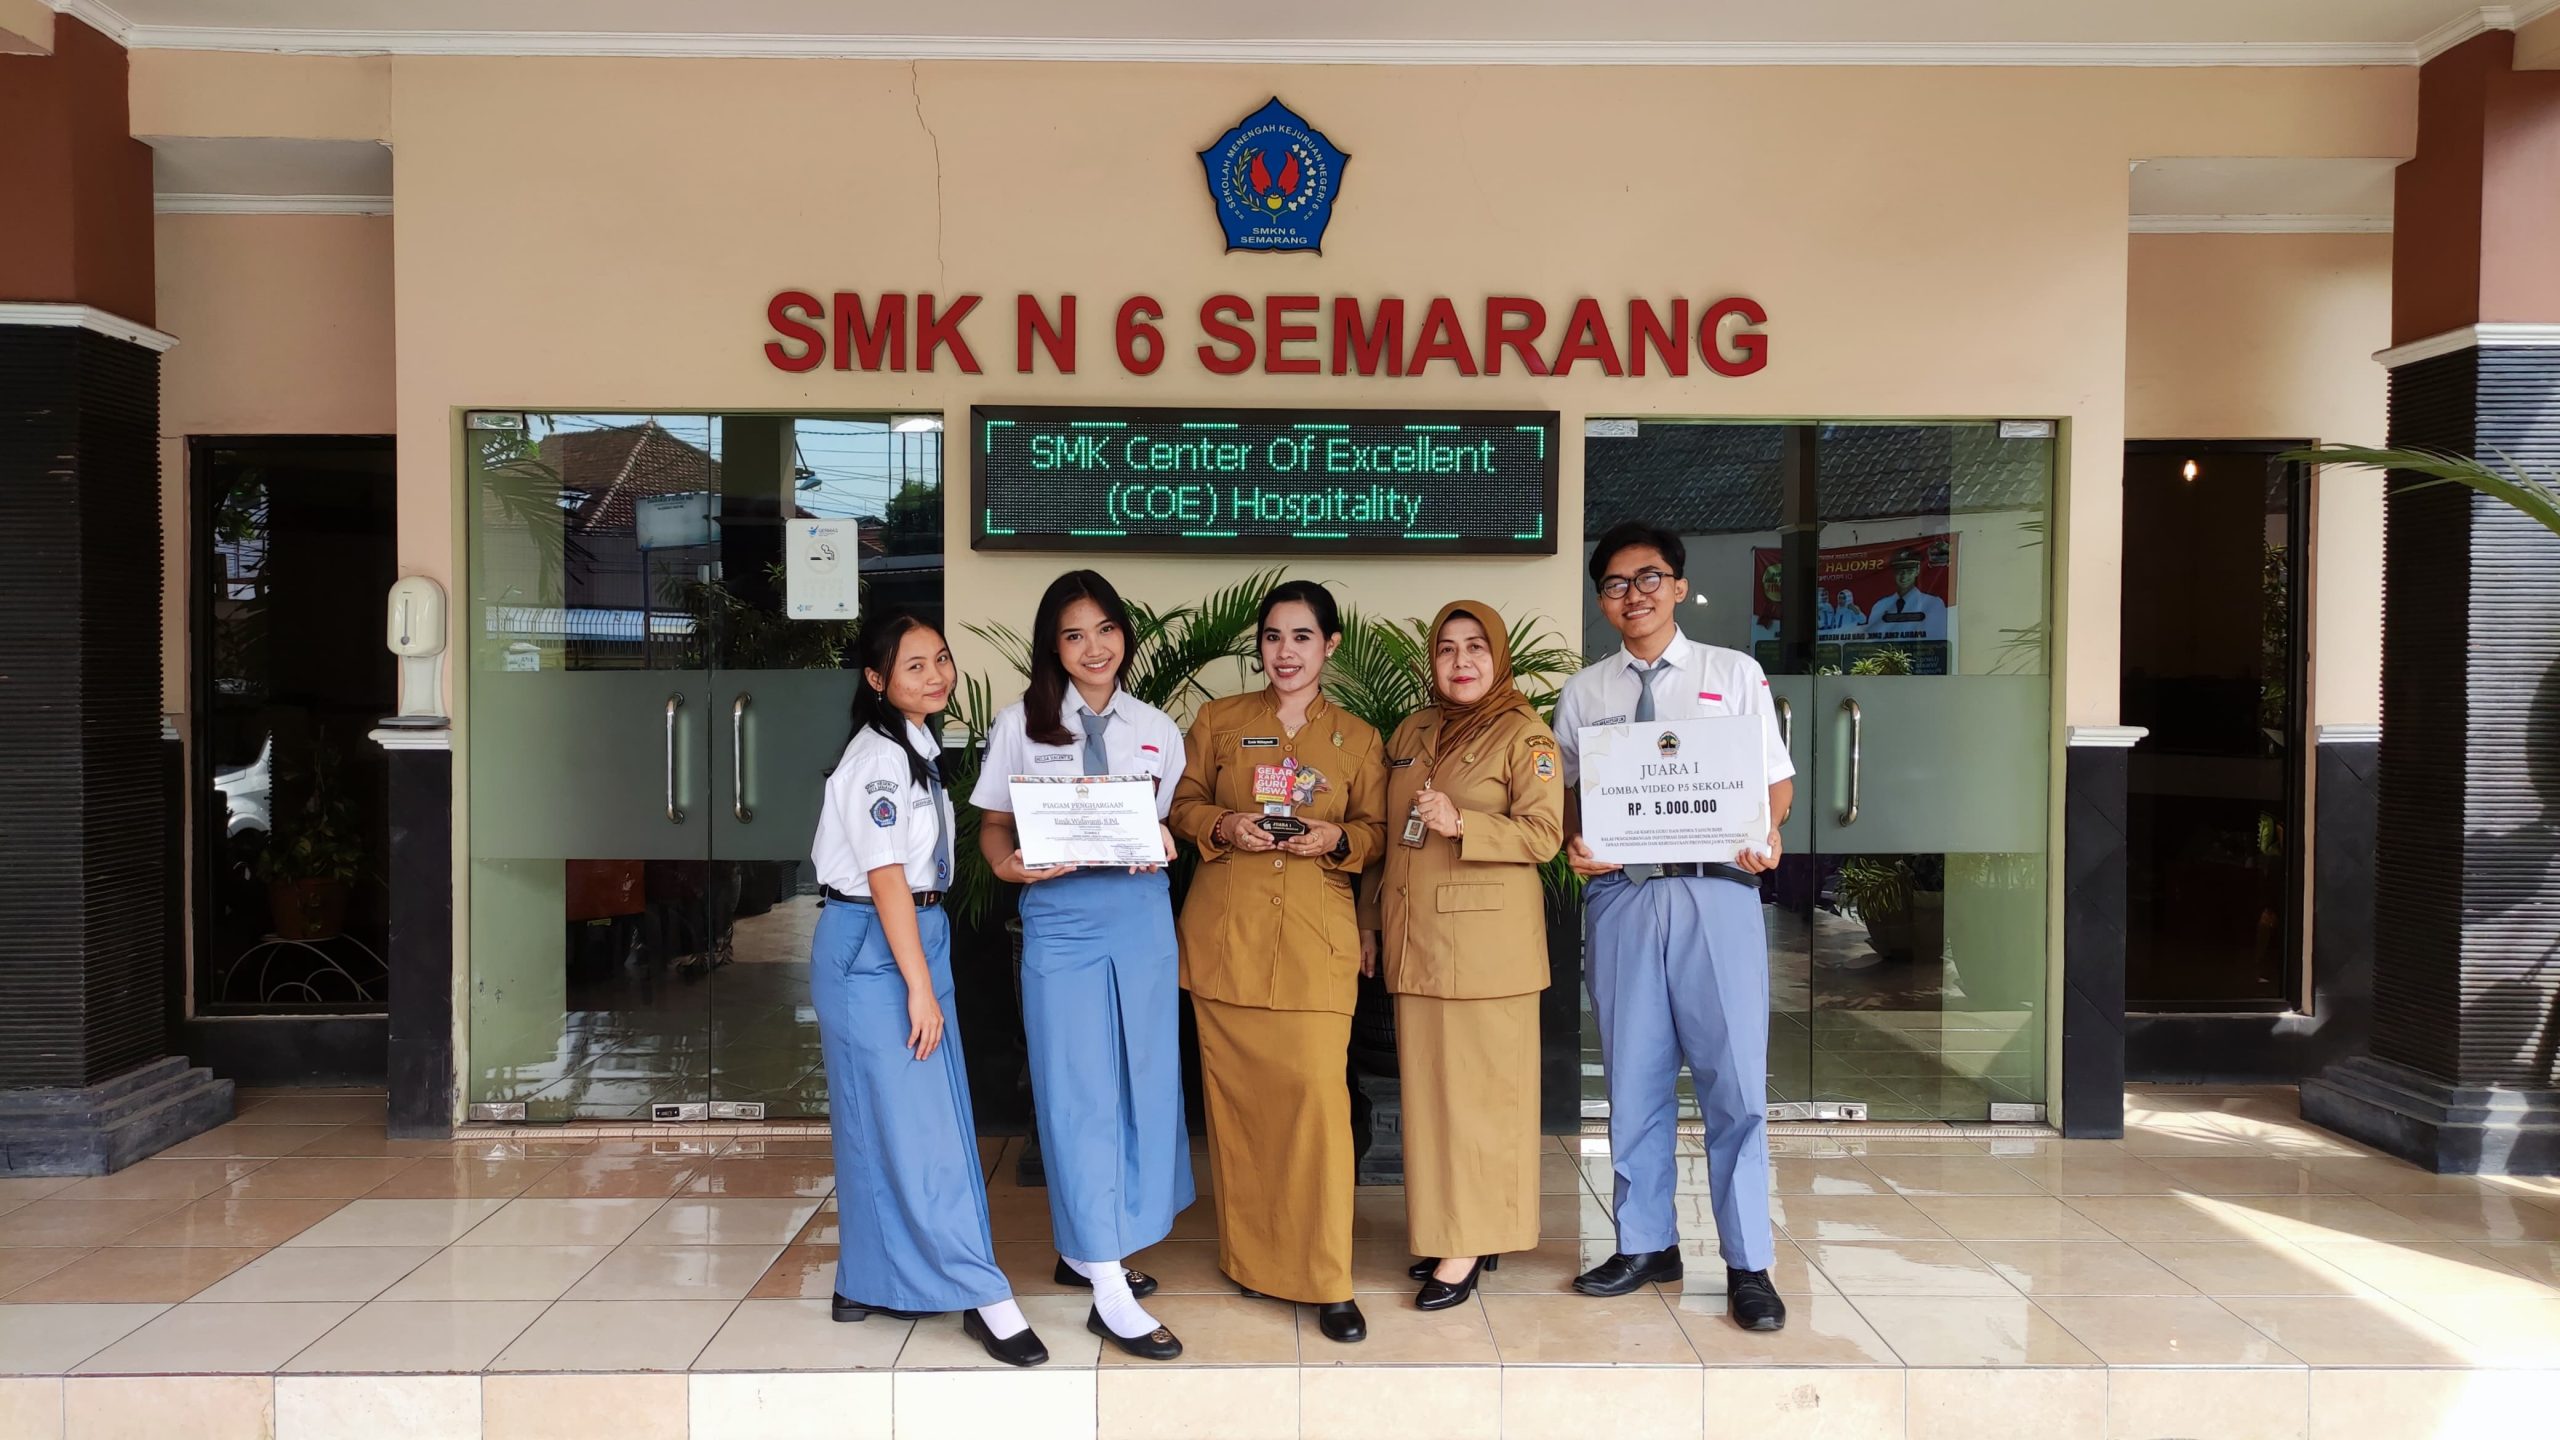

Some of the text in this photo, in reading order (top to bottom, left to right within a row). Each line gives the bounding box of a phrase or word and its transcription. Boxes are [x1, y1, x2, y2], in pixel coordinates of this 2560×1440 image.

[1221, 124, 1328, 211] SEKOLAH MENENGAH KEJURUAN NEGERI 6
[1252, 227, 1296, 235] SMKN 6
[1240, 236, 1308, 245] SEMARANG
[764, 291, 1768, 378] SMK N 6 SEMARANG
[1032, 435, 1496, 474] SMK Center Of Excellent
[1109, 481, 1422, 528] (COE) Hospitality
[1258, 767, 1293, 776] GELAR
[1640, 763, 1689, 779] JUARA
[1256, 786, 1287, 795] SISWA
[1257, 779, 1288, 788] GURU
[1601, 780, 1744, 796] LOMBA VIDEO P5 SEKOLAH
[1071, 801, 1124, 809] PENGHARGAAN
[1628, 799, 1717, 816] RP. 5.000.000
